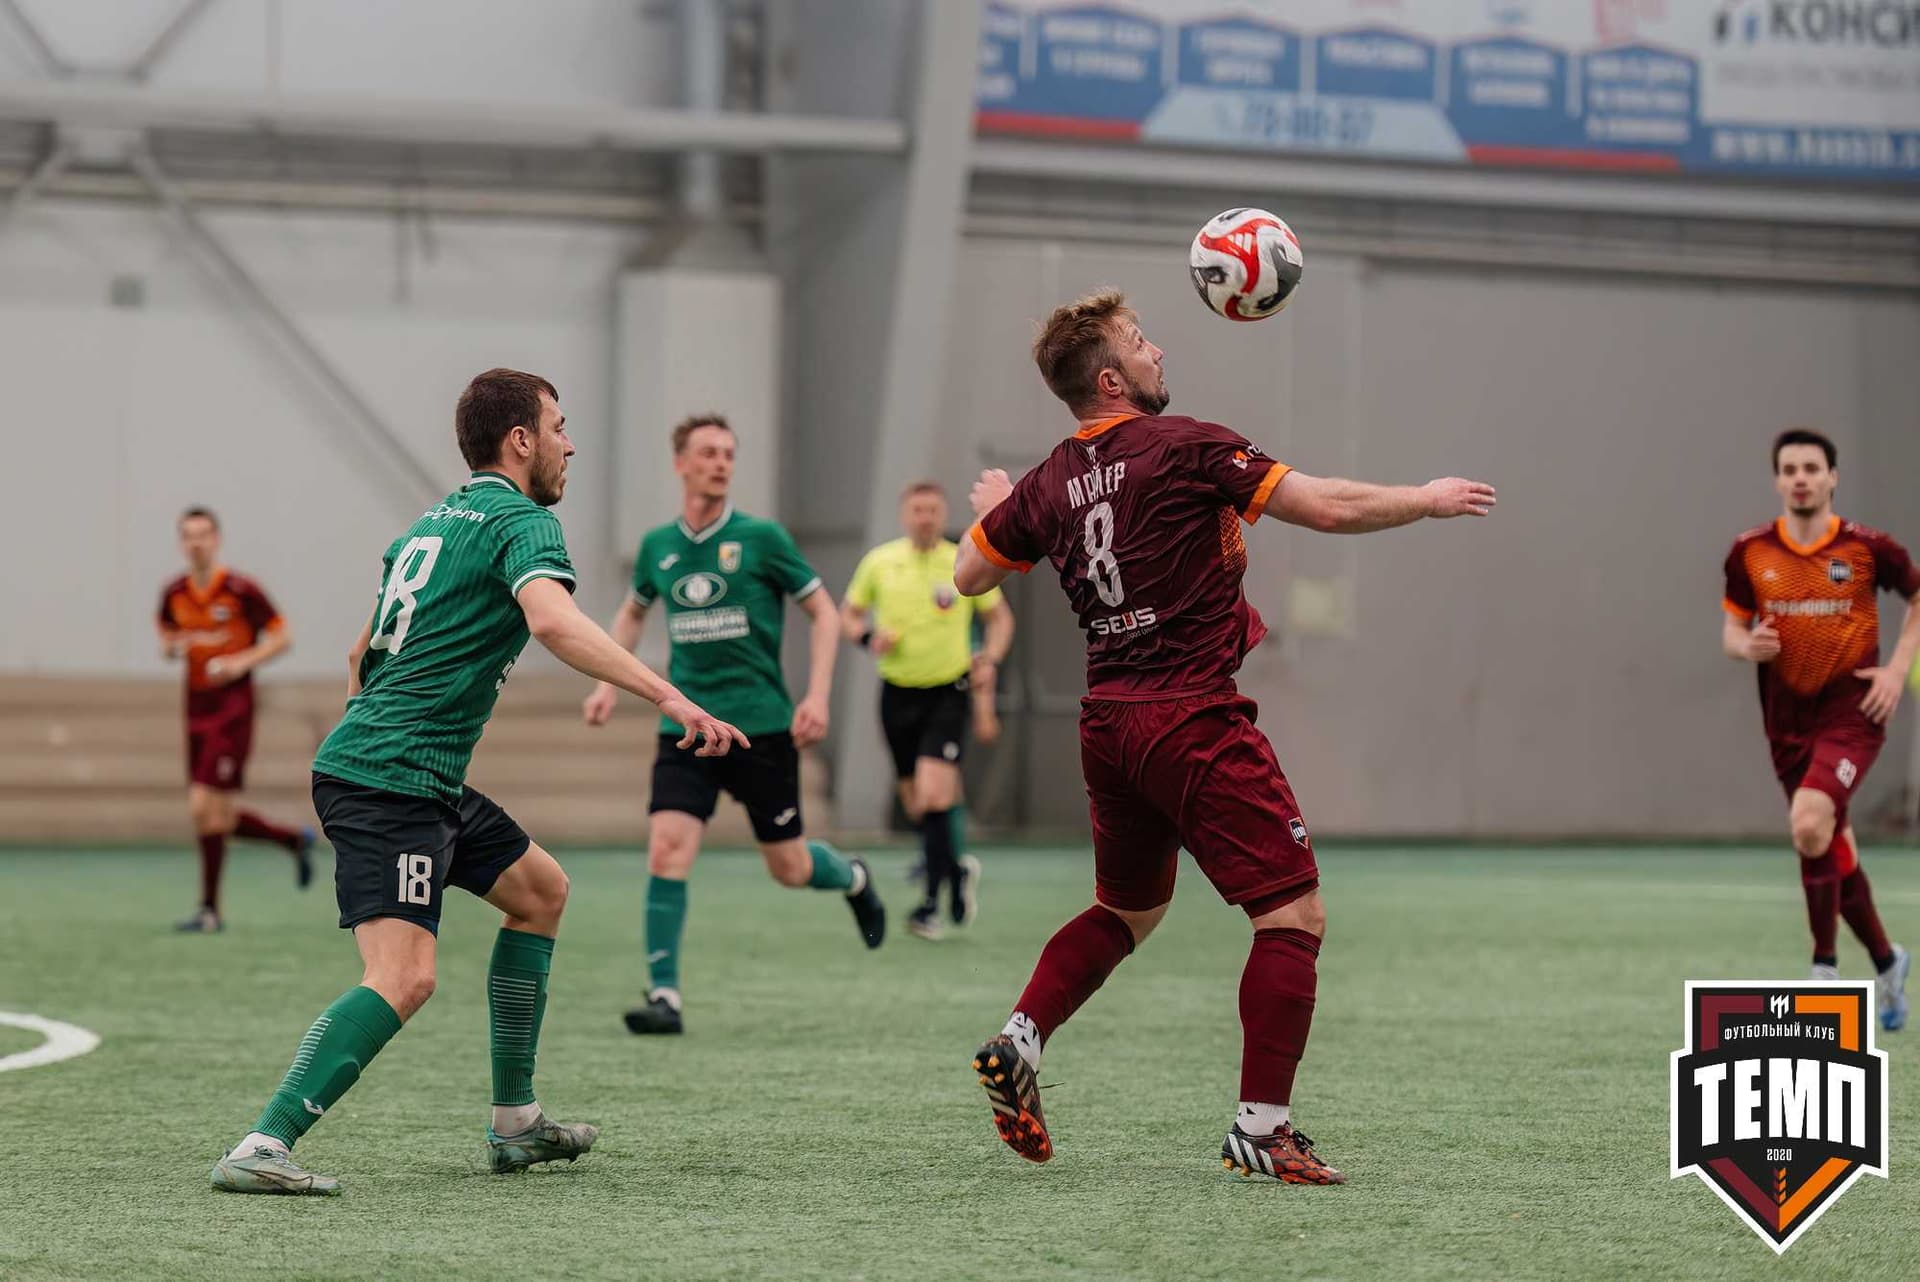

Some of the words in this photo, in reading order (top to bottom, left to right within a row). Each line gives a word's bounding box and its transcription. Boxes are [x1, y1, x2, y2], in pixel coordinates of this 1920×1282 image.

[1066, 461, 1126, 509] МАЙЕР
[1084, 501, 1125, 608] 8
[1090, 607, 1157, 635] SEUS
[396, 852, 433, 906] 18
